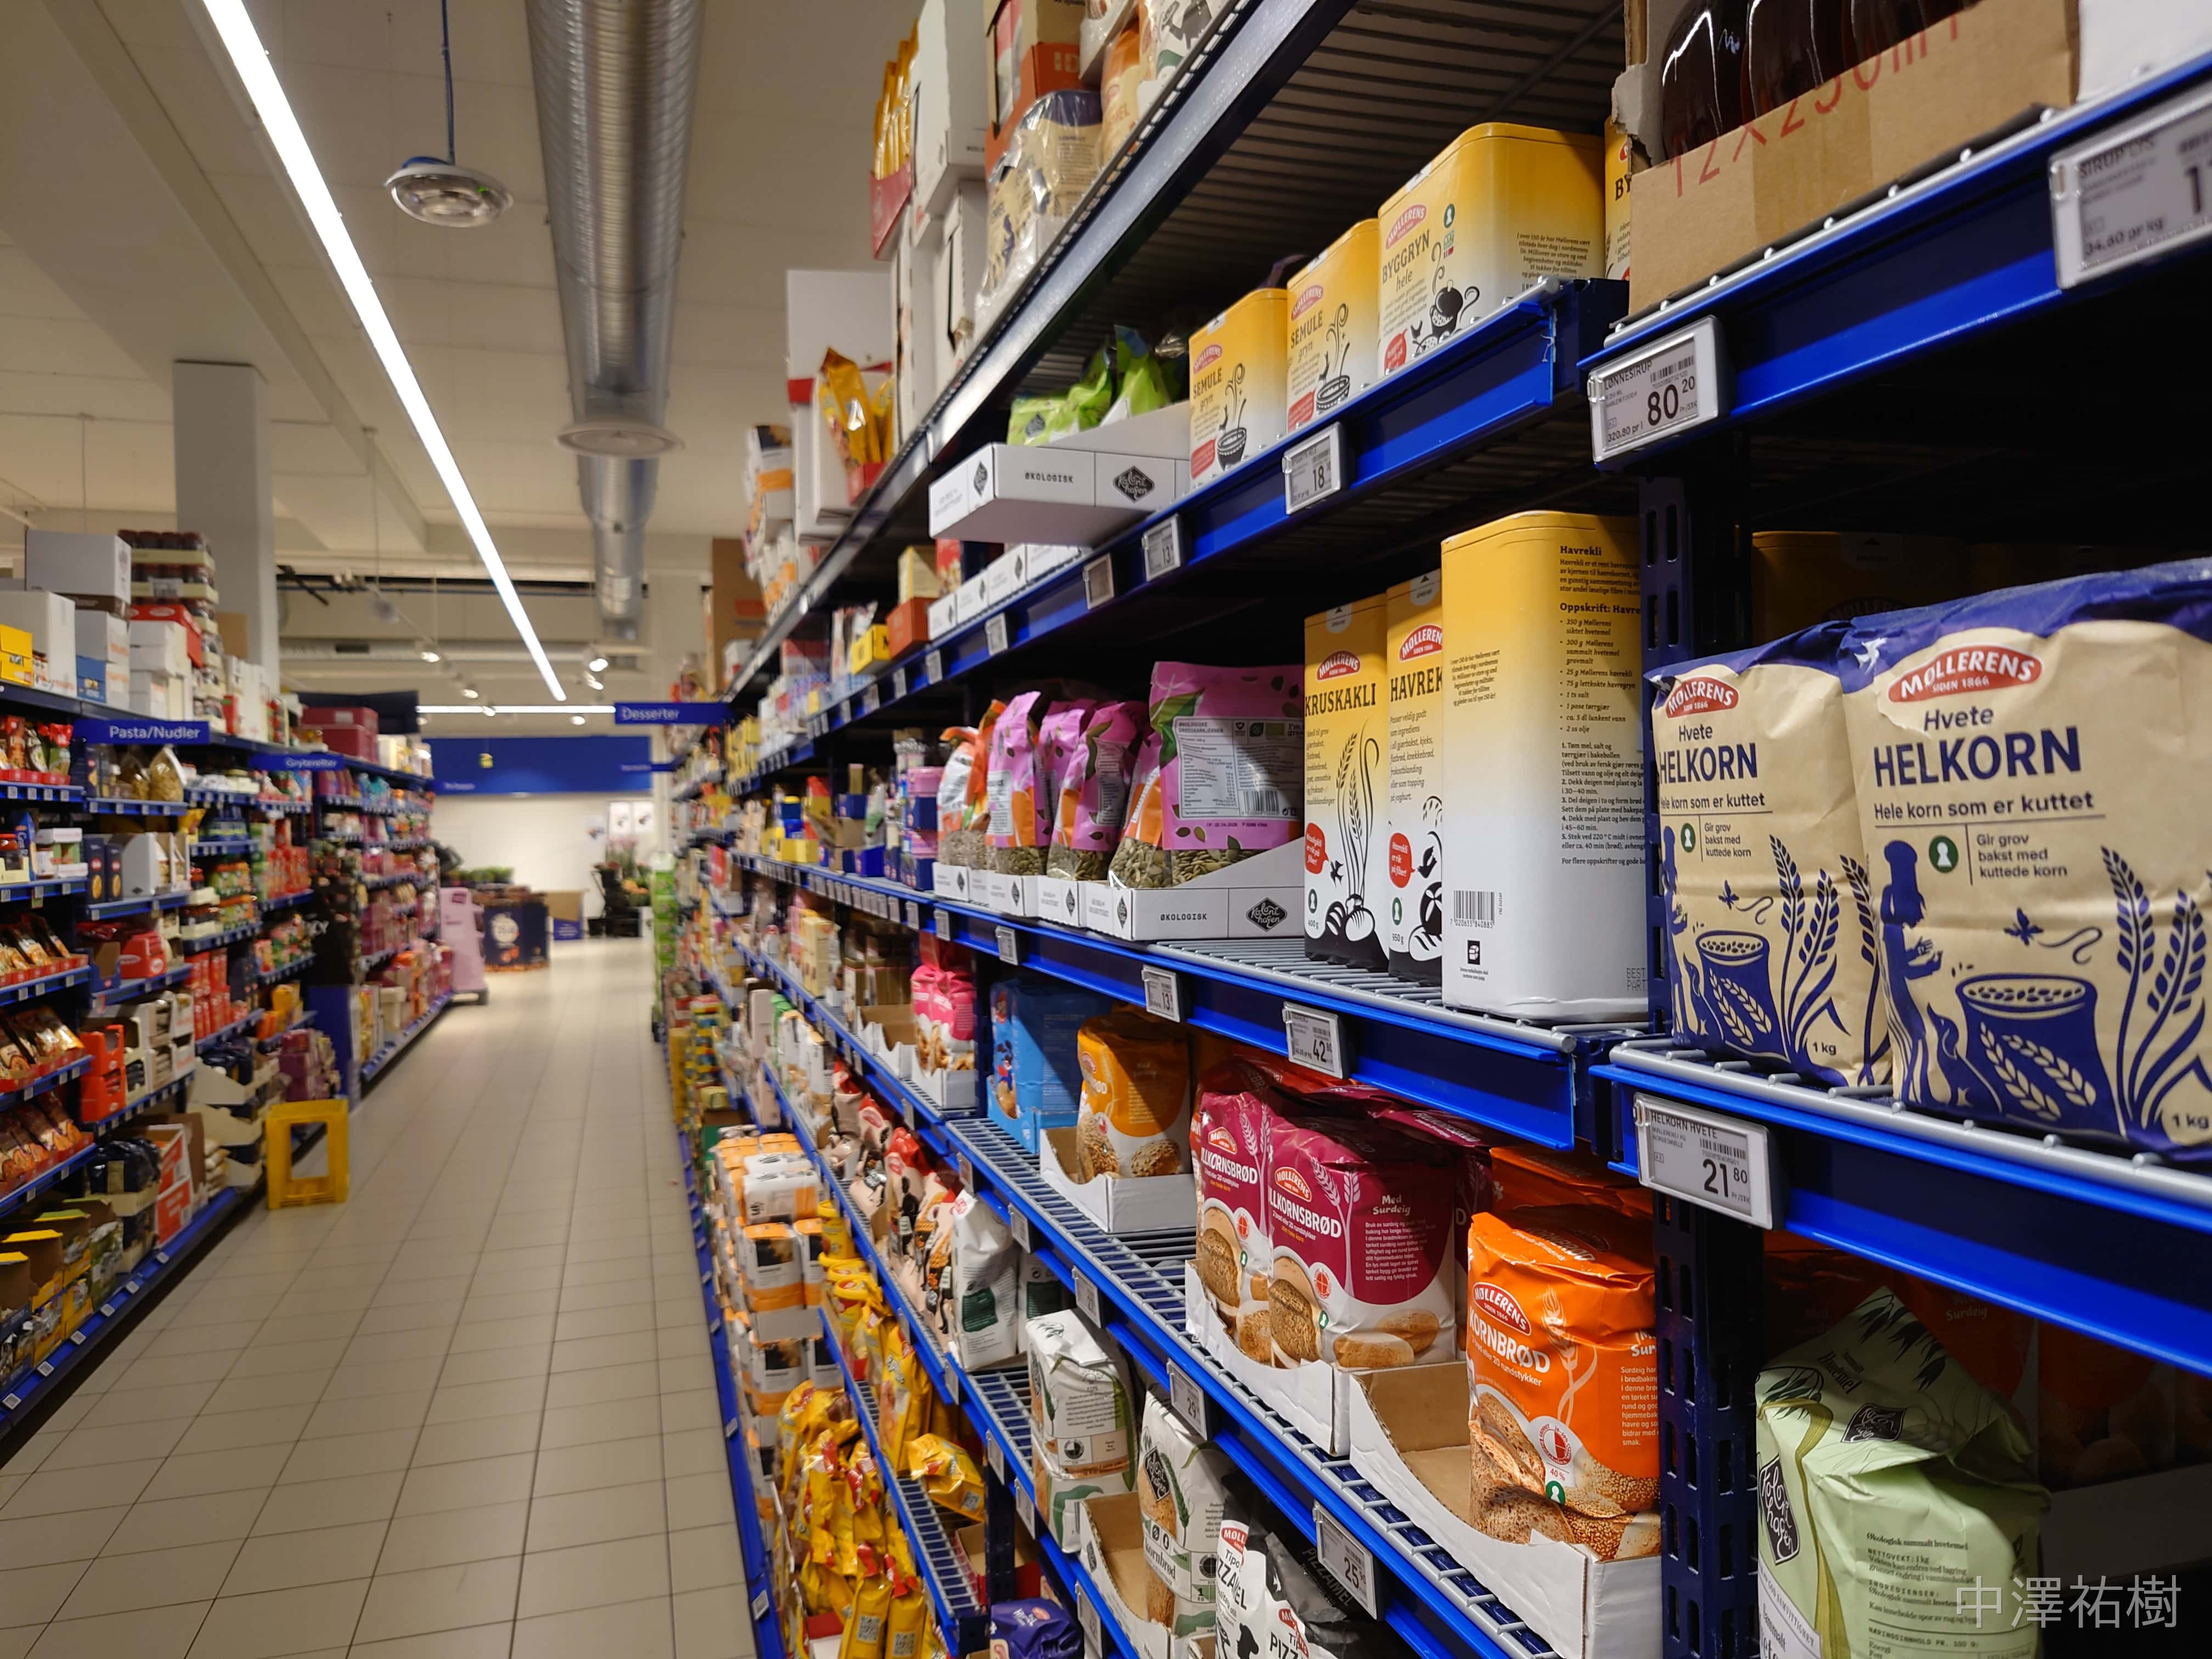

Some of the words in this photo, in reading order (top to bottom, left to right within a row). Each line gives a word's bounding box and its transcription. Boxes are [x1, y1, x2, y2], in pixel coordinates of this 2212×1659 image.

[1383, 229, 1430, 284] BYGGRYN
[1396, 269, 1413, 292] hele
[1291, 311, 1323, 348] SEMULE
[1298, 344, 1313, 363] gryn
[1193, 367, 1222, 399] SEMULE
[1200, 394, 1213, 411] gryn
[1647, 384, 1679, 426] 80
[1682, 376, 1695, 393] 20
[1607, 426, 1630, 442] 320.80
[1632, 424, 1639, 434] pr
[1025, 472, 1073, 483] ØKOLOGISK
[1313, 465, 1324, 491] 18
[1560, 545, 1601, 556] Havrekli
[1560, 602, 1611, 614] Oppskrift:
[1594, 648, 1620, 657] hvetemel
[1319, 653, 1359, 678] MØLLERENS
[1609, 669, 1633, 678] havrekli
[1901, 651, 2034, 698] MØLLERENS
[1580, 680, 1606, 688] lettkokte
[1607, 681, 1636, 691] havregryn
[1932, 681, 1957, 692] SIDEN
[1962, 676, 1989, 687] 1866
[1305, 683, 1376, 716] KRUSKAKLI
[1668, 681, 1734, 714] MØLLERENS
[1694, 701, 1708, 709] 1866
[622, 706, 680, 720] Desserter
[1585, 703, 1610, 712] tørrgjær
[1588, 714, 1611, 722] lunkent
[1924, 707, 1994, 732] Hvete
[110, 726, 200, 740] Pasta/Nudler
[1679, 724, 1713, 742] Hvete
[1660, 742, 1758, 784] HELKORN
[1874, 726, 2081, 787] HELKORN
[1672, 796, 1688, 809] korn
[1690, 797, 1709, 809] som
[1713, 797, 1723, 808] er
[1727, 792, 1765, 807] kuttet
[1875, 803, 1903, 820] Hele
[1908, 803, 1942, 818] korn
[1948, 801, 1986, 816] som
[1994, 799, 2014, 814] er
[2021, 791, 2094, 813] kuttet
[1705, 823, 1714, 832] Gir
[1716, 824, 1731, 836] grov
[1706, 835, 1723, 844] bakst
[1725, 834, 1740, 844] med
[1977, 833, 1994, 846] Gir
[1999, 834, 2029, 849] grov
[1706, 847, 1731, 857] kuttede
[1733, 848, 1751, 857] korn
[1979, 849, 2012, 862] bakst
[2017, 848, 2047, 861] med
[1587, 857, 1617, 866] oppskrifter
[1980, 865, 2029, 877] kuttede
[2033, 865, 2067, 877] korn
[1160, 913, 1207, 921] ØKOLOGISK
[1626, 968, 1646, 979] BEST
[1163, 992, 1170, 1010] 13
[1313, 1039, 1327, 1062] 42
[1813, 1041, 1818, 1052] 1
[1821, 1042, 1836, 1056] kg
[1651, 1111, 1688, 1131] HELKORN
[1690, 1123, 1717, 1138] HVETE
[2172, 1114, 2180, 1127] 1
[2186, 1113, 2209, 1129] kg
[1277, 1172, 1309, 1198] MØLLERENS
[1702, 1159, 1728, 1198] 21
[1734, 1167, 1747, 1183] 80
[1382, 1194, 1402, 1205] Med
[1373, 1205, 1410, 1216] Surdeig
[1475, 1288, 1526, 1330] MØLLERENS
[1470, 1306, 1550, 1374] KORNBRØD
[1493, 1356, 1500, 1366] 20
[1500, 1362, 1542, 1387] rundstykker
[1550, 1469, 1558, 1477] 40
[1226, 1549, 1240, 1568] Tipo
[1345, 1558, 1359, 1589] 25
